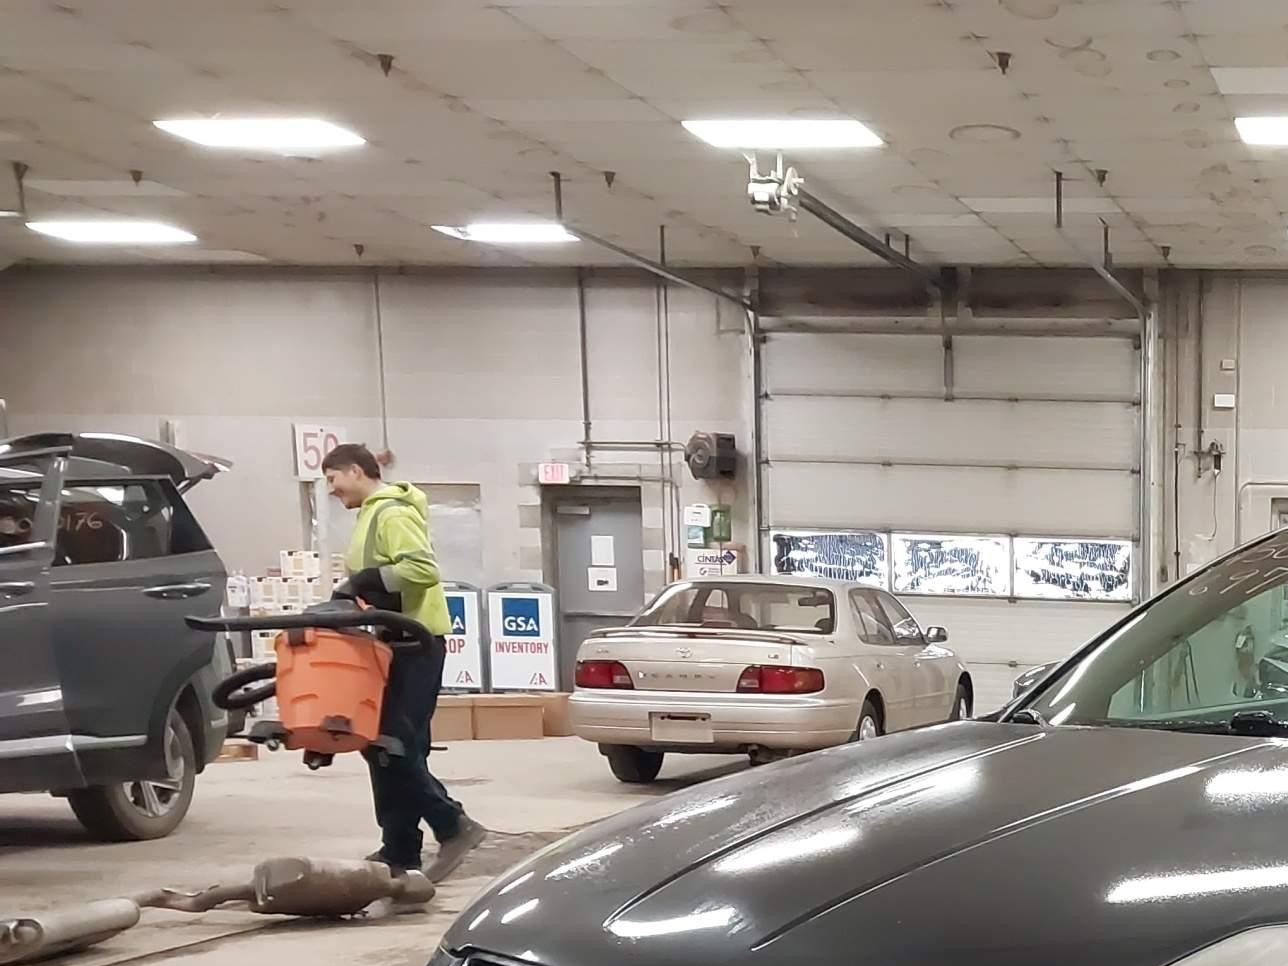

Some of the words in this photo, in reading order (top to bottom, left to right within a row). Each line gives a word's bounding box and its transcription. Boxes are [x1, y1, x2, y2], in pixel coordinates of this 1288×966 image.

[544, 465, 563, 480] EXIT
[504, 616, 538, 631] GSA
[444, 638, 465, 654] OP
[495, 641, 549, 654] INVENTORY
